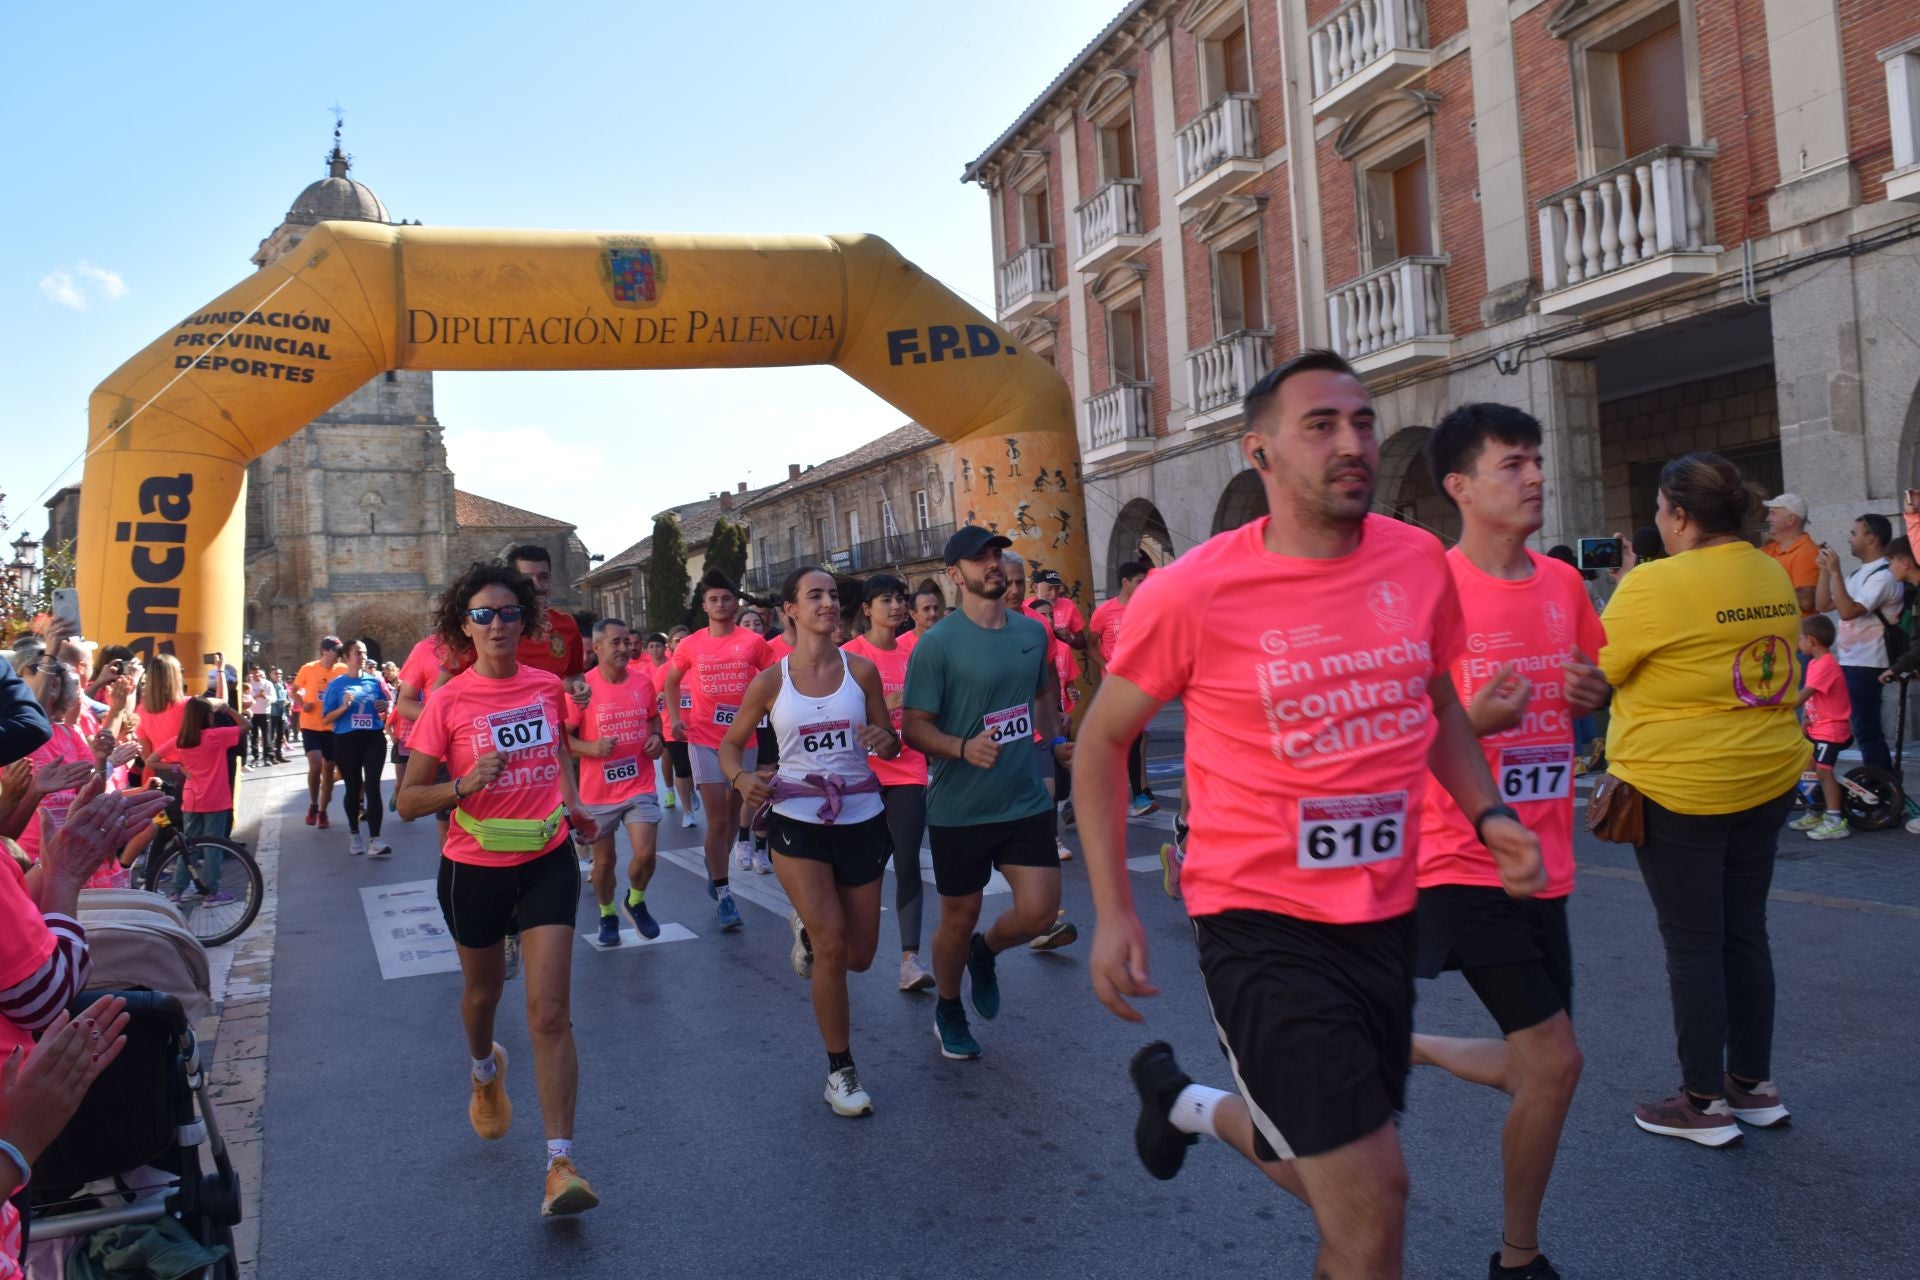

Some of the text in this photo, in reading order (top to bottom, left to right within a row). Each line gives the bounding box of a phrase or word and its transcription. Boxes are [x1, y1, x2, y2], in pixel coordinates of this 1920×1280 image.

[180, 310, 331, 334] FUNDACIÓN
[407, 306, 837, 345] DIPUTACIÓN DE PALENCIA
[174, 332, 331, 361] PROVINCIAL
[887, 325, 1017, 366] F.P.D.
[174, 355, 315, 383] DEPORTES
[713, 660, 749, 671] marcha
[1267, 638, 1432, 687] En marcha
[701, 672, 737, 682] contra
[681, 699, 692, 707] 81
[1274, 679, 1405, 722] contra
[353, 719, 371, 727] 700
[716, 711, 734, 724] 66
[498, 720, 543, 747] 607
[804, 731, 846, 752] 641
[1817, 742, 1829, 761] 7
[607, 764, 636, 780] 668
[1504, 765, 1566, 797] 617
[1307, 818, 1397, 860] 616
